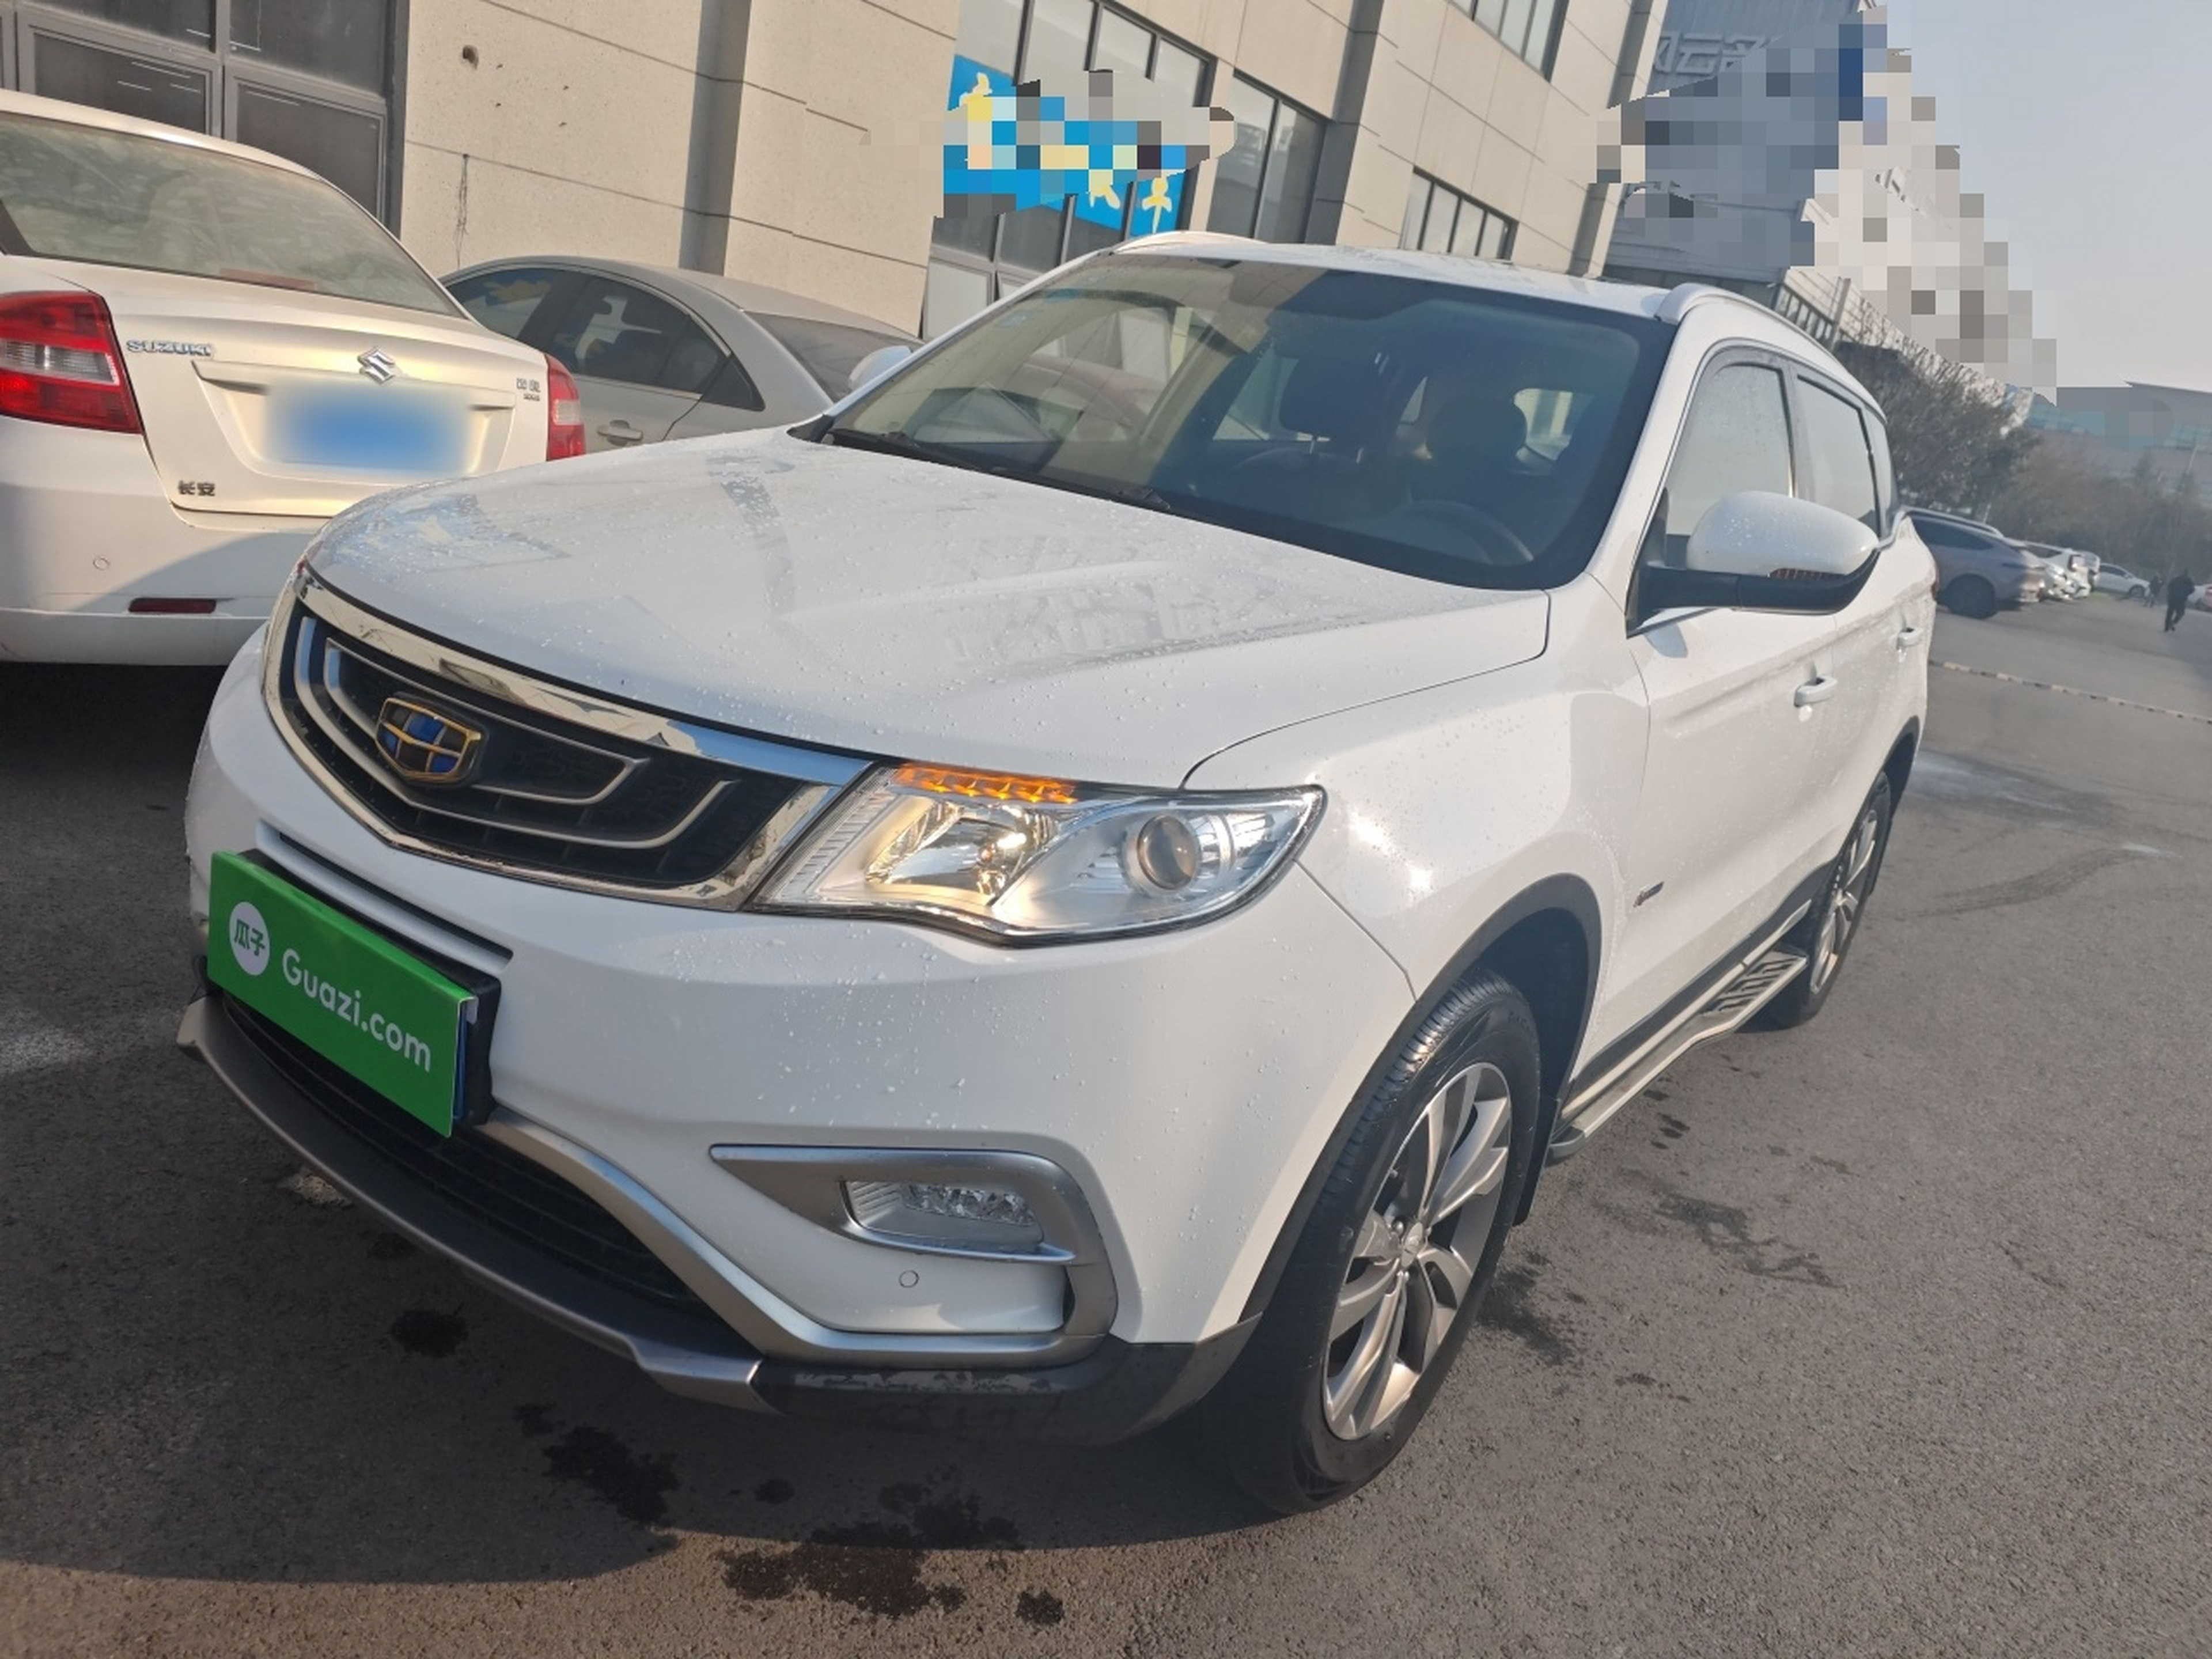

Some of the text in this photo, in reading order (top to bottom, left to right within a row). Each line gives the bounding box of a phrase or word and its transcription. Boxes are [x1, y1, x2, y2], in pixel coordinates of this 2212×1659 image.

[126, 340, 213, 357] SUZUKI
[234, 919, 266, 956] 瓜子
[282, 949, 431, 1073] Guazi.com
